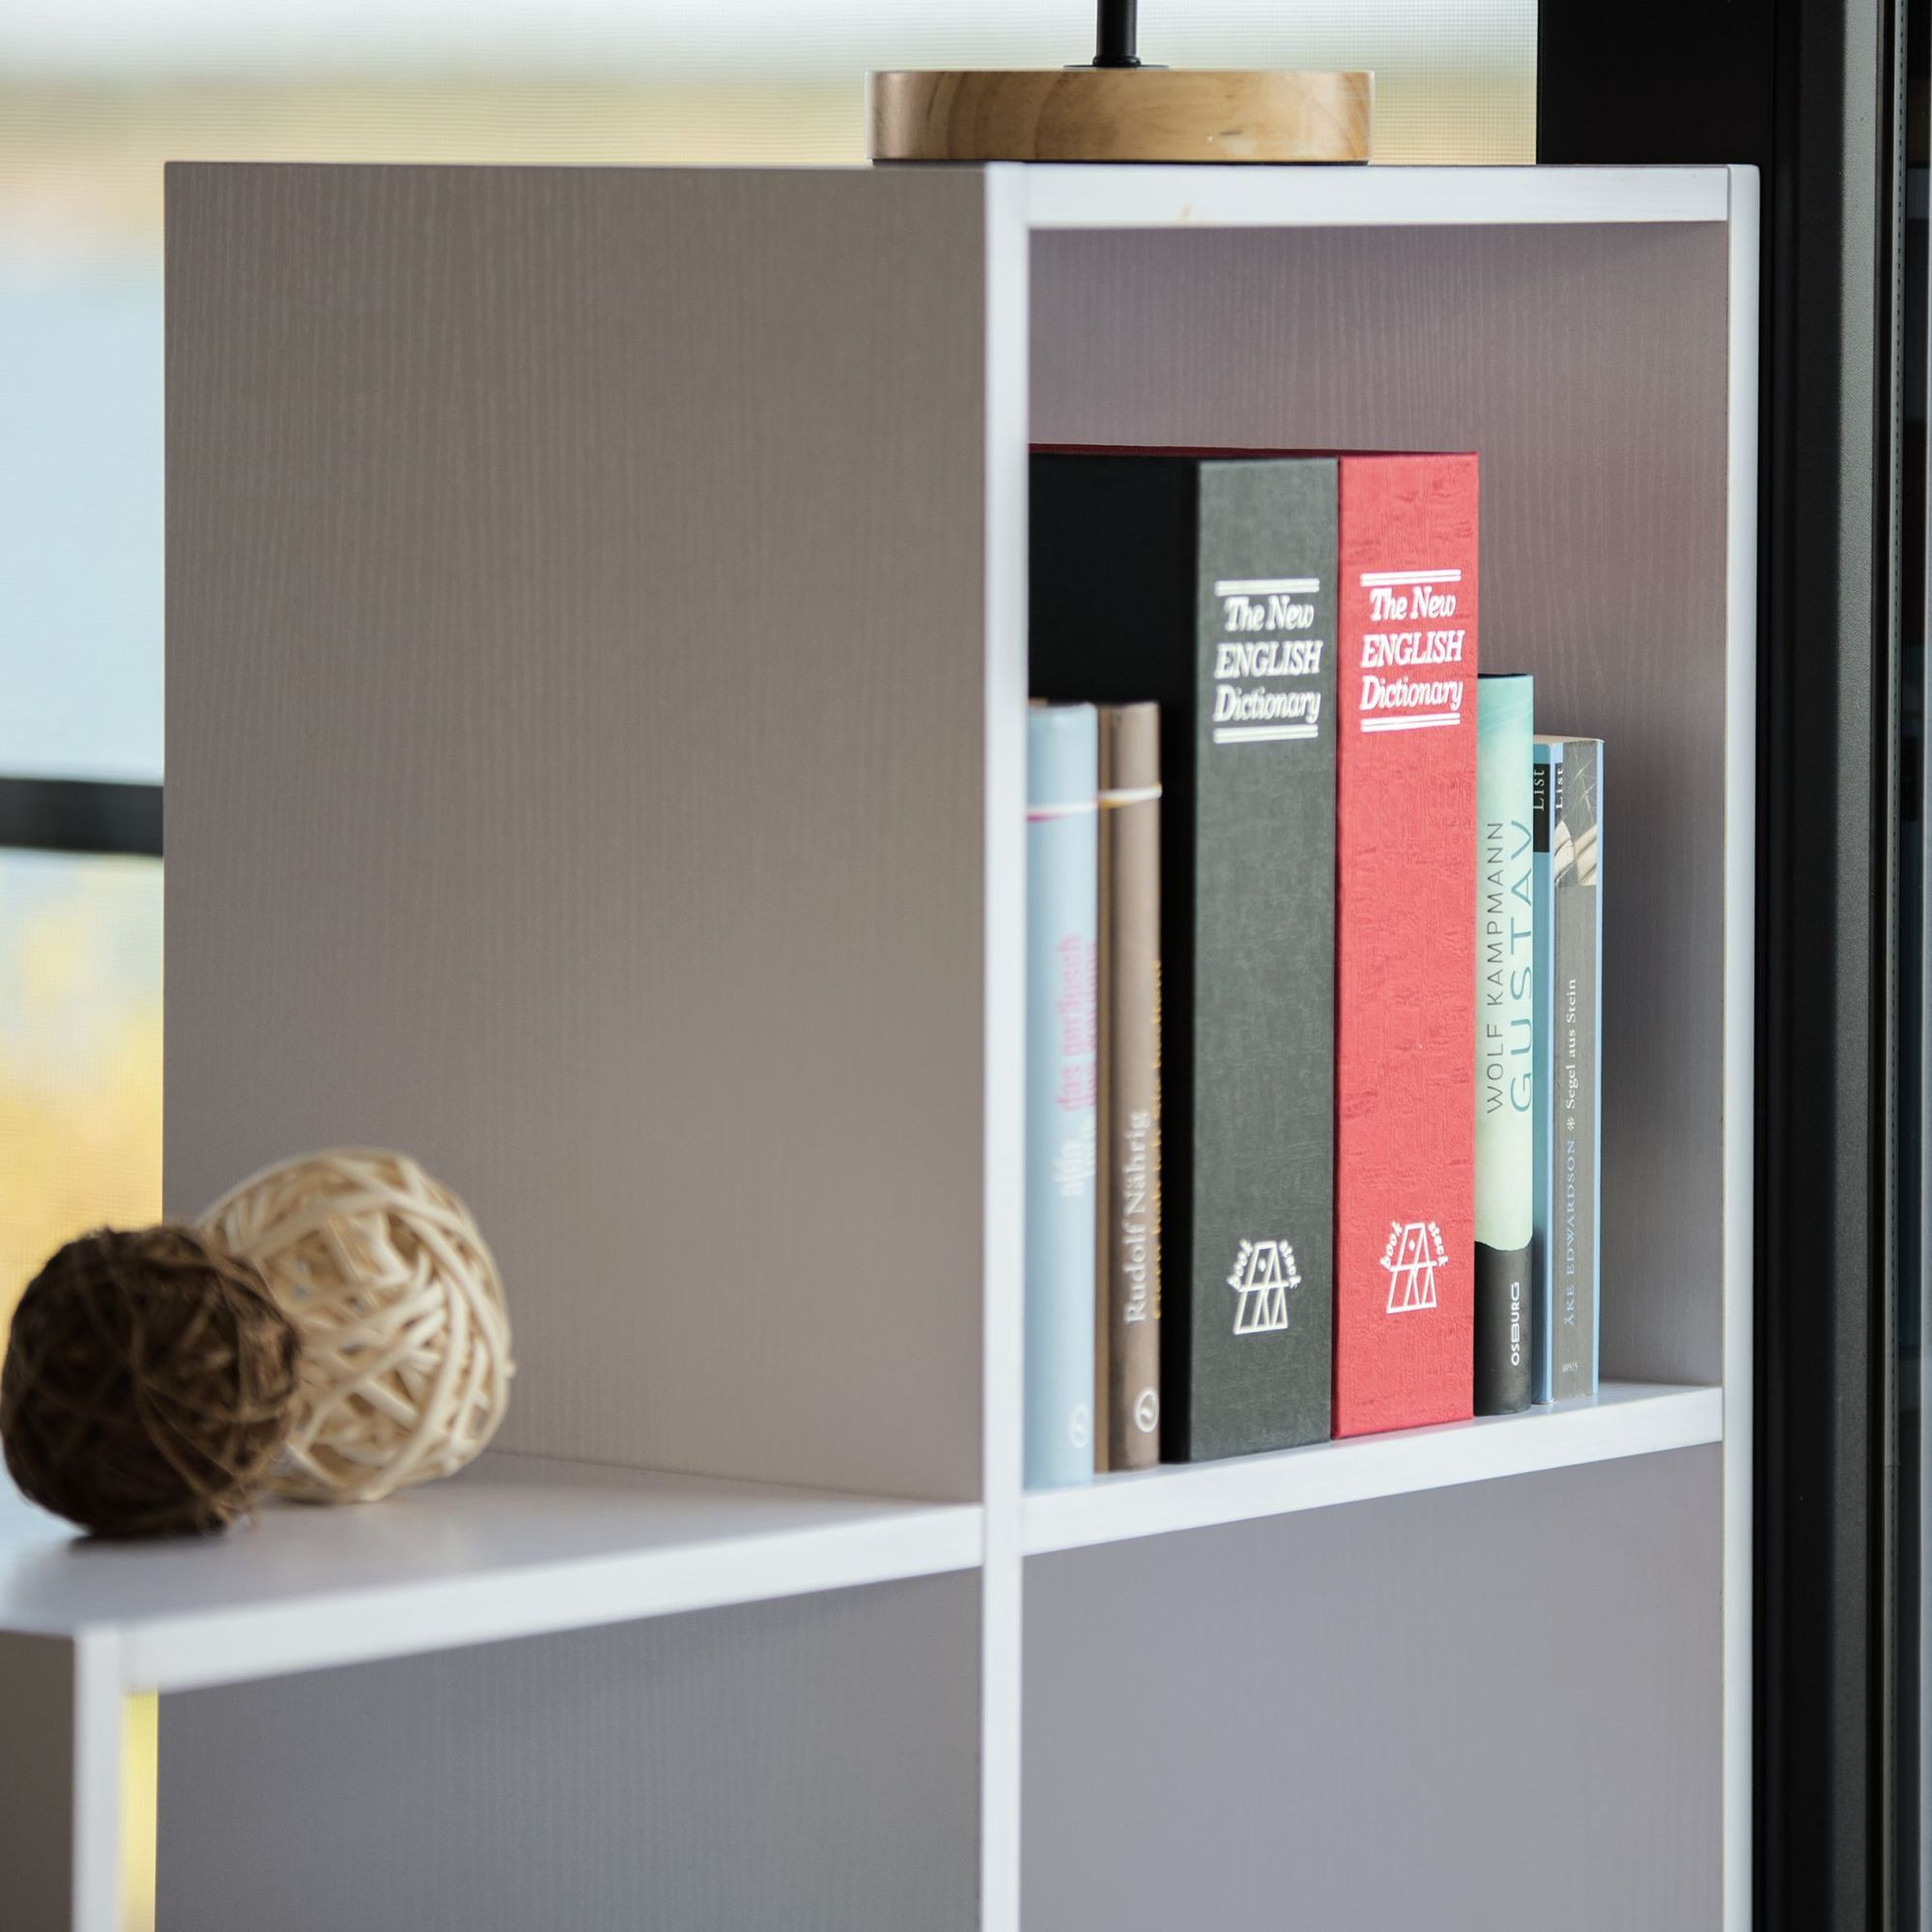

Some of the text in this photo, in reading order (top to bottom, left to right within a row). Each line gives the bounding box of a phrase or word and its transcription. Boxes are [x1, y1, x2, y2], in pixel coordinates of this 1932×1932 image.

[1224, 594, 1315, 632] The New
[1370, 585, 1457, 621] The New
[1213, 639, 1323, 679] ENGLISH
[1359, 629, 1465, 668] ENGLISH
[1212, 684, 1321, 724] Dictionary
[1358, 674, 1464, 711] Dictionary
[1533, 769, 1546, 811] List
[1555, 768, 1564, 810] List
[1486, 822, 1504, 1114] WOLF KAMPMANN
[1510, 819, 1532, 1112] GUSTAV
[1563, 979, 1579, 1327] ÅKE EDWARDSON Segel aus Stein
[1122, 1110, 1151, 1323] Rudolf Nährig
[1510, 1281, 1520, 1366] OSBURG
